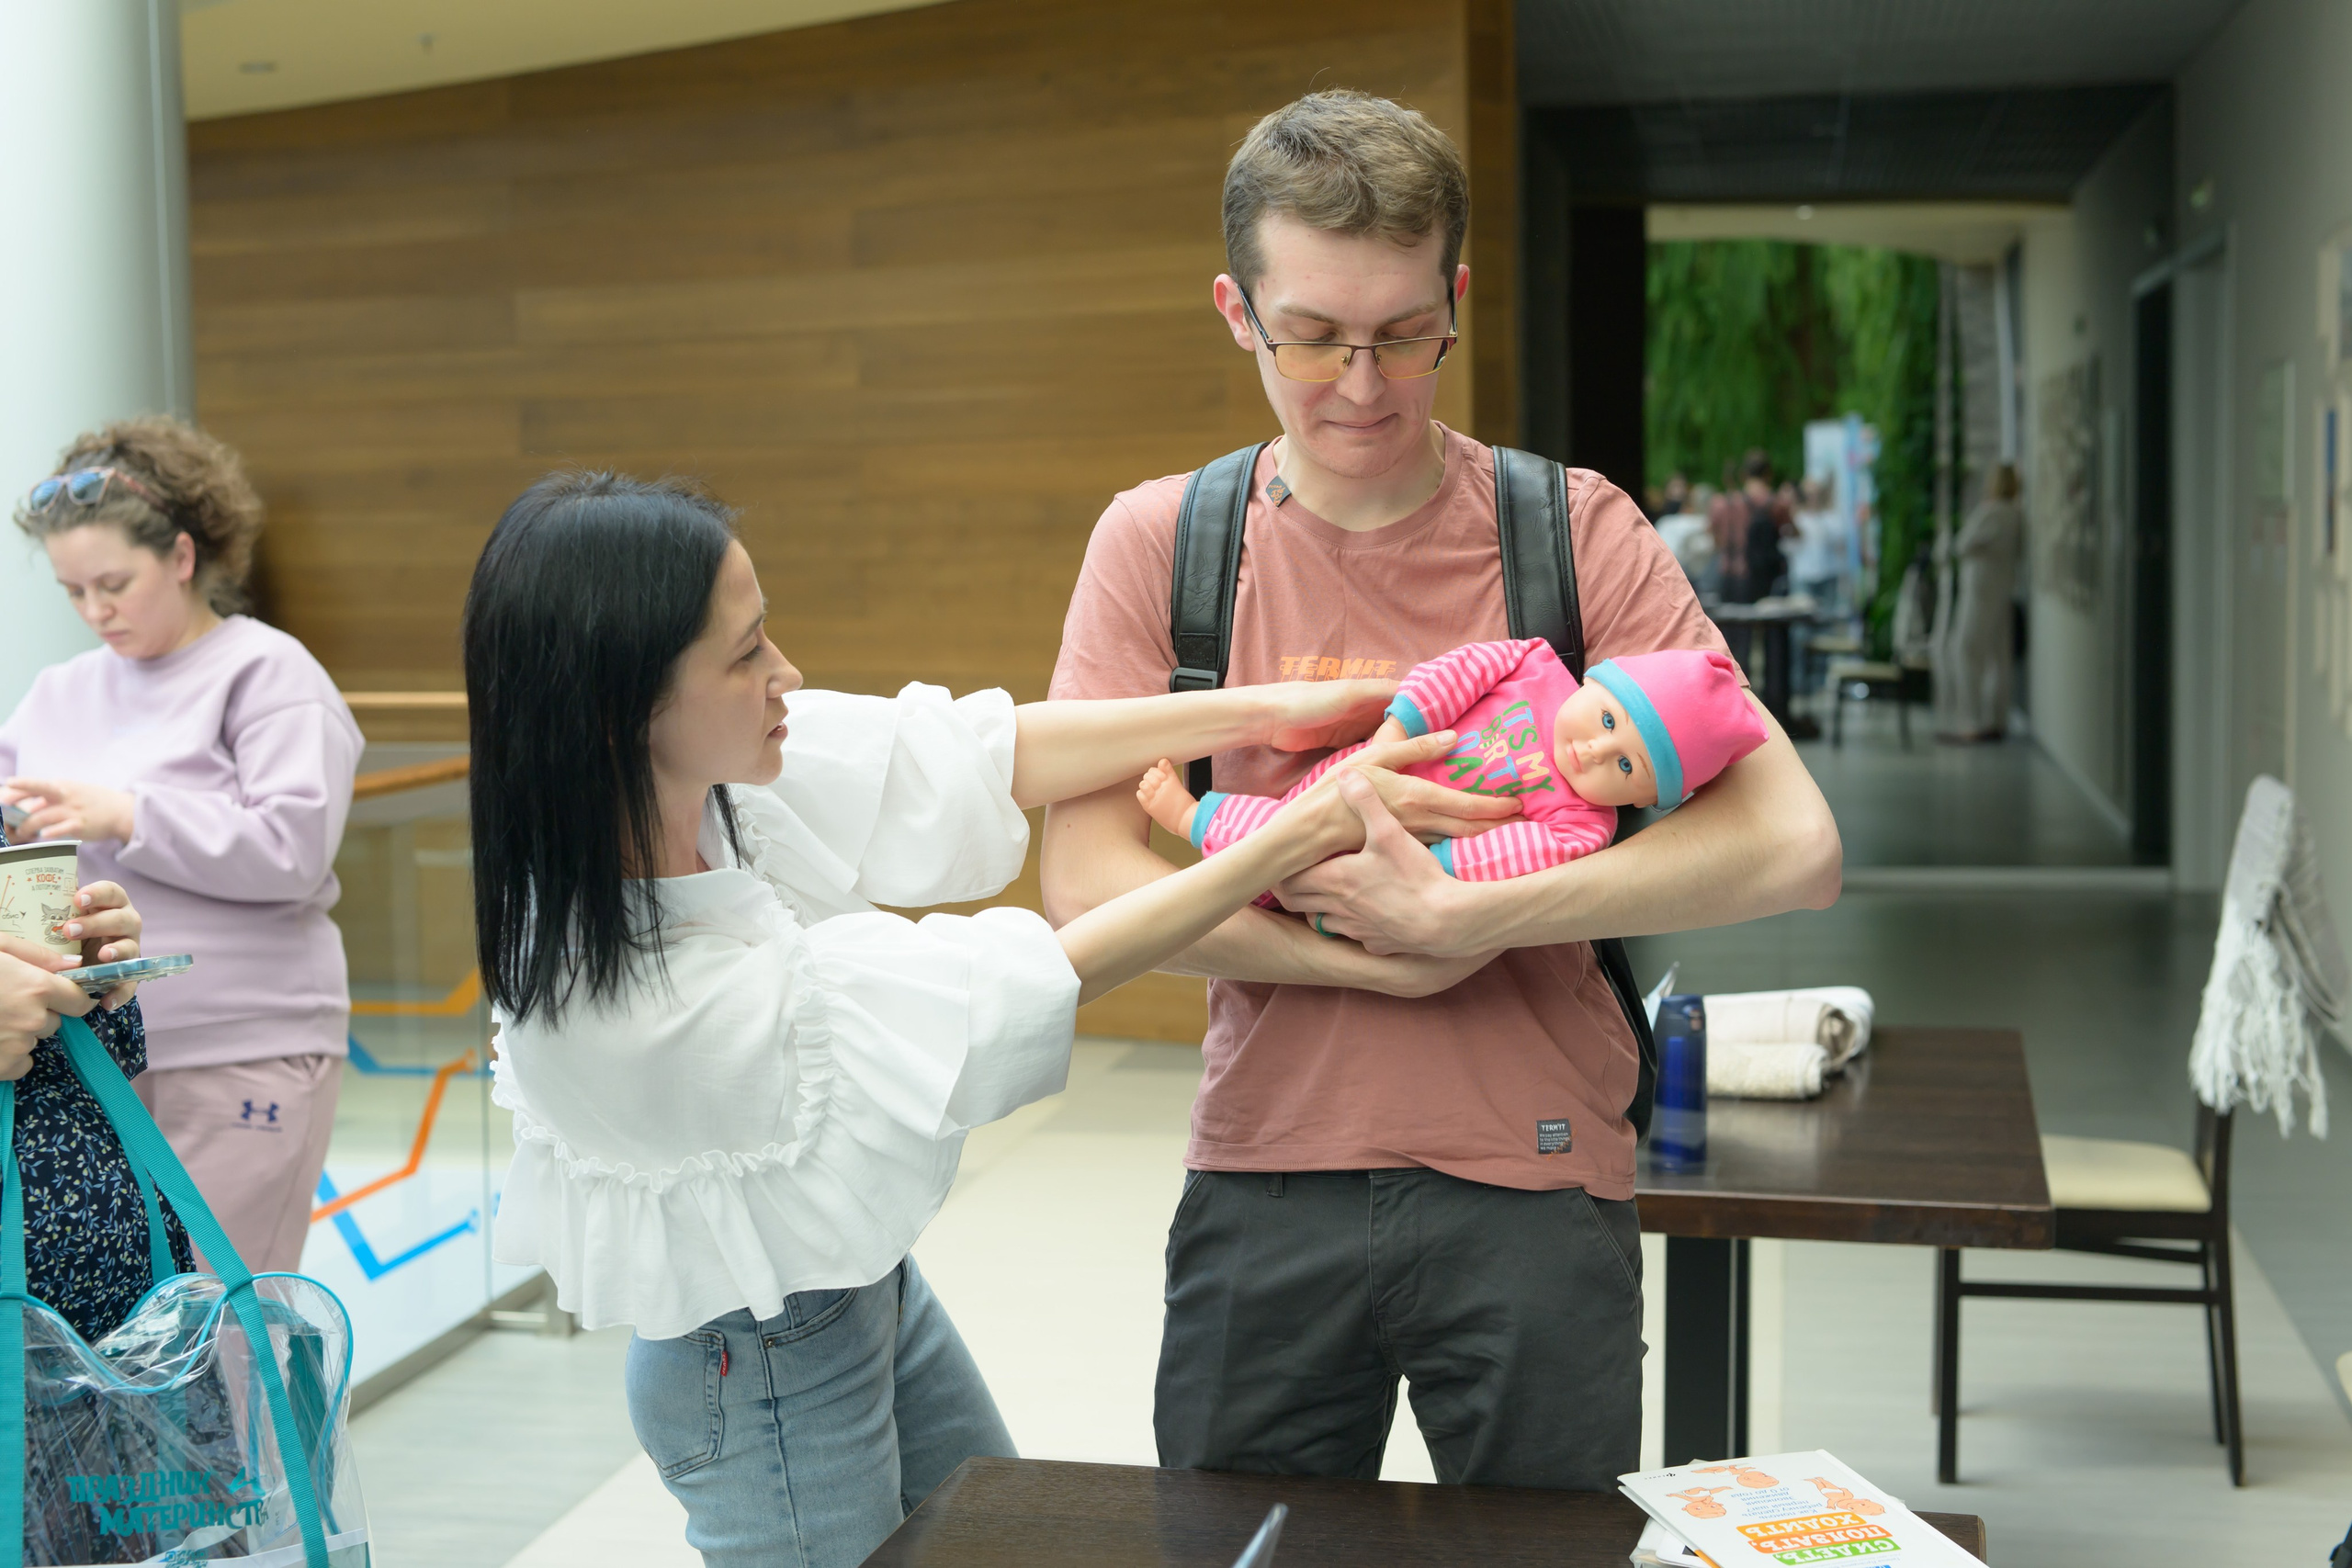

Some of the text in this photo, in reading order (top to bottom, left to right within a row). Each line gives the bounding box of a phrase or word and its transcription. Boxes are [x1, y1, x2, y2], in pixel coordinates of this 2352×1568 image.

[1280, 656, 1396, 682] TERMIT
[1502, 700, 1555, 794] IT'S MY
[64, 1470, 211, 1506] ПРАЗДНИК
[1746, 1514, 1860, 1538] ХОДИТЬ
[1750, 1526, 1888, 1552] ПОЛЗАТЬ,
[1775, 1540, 1894, 1564] СИДЕТЬ,
